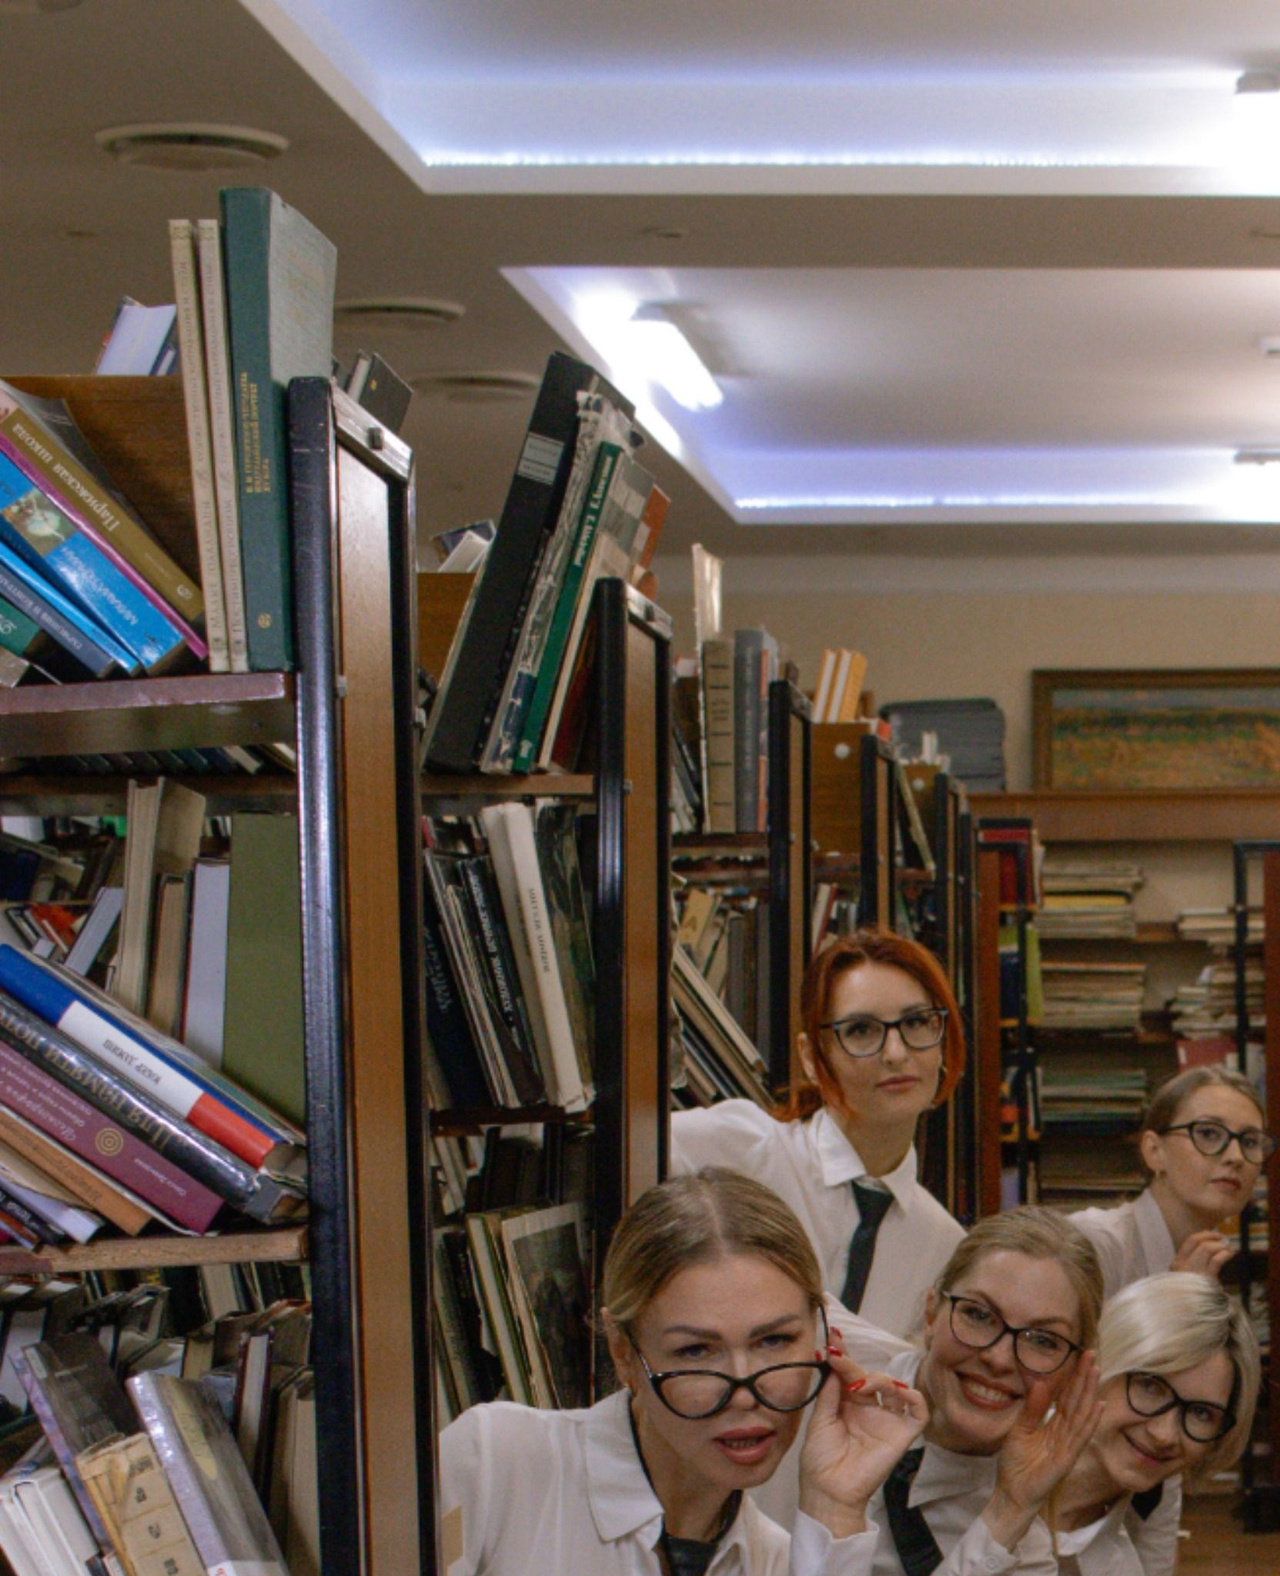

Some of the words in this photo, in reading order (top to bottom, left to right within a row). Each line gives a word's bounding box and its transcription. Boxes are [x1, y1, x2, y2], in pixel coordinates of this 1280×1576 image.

[8, 421, 55, 466] школа
[47, 459, 124, 534] Парижская
[41, 1041, 129, 1114] памяти
[132, 1060, 163, 1086] ЮБЕР
